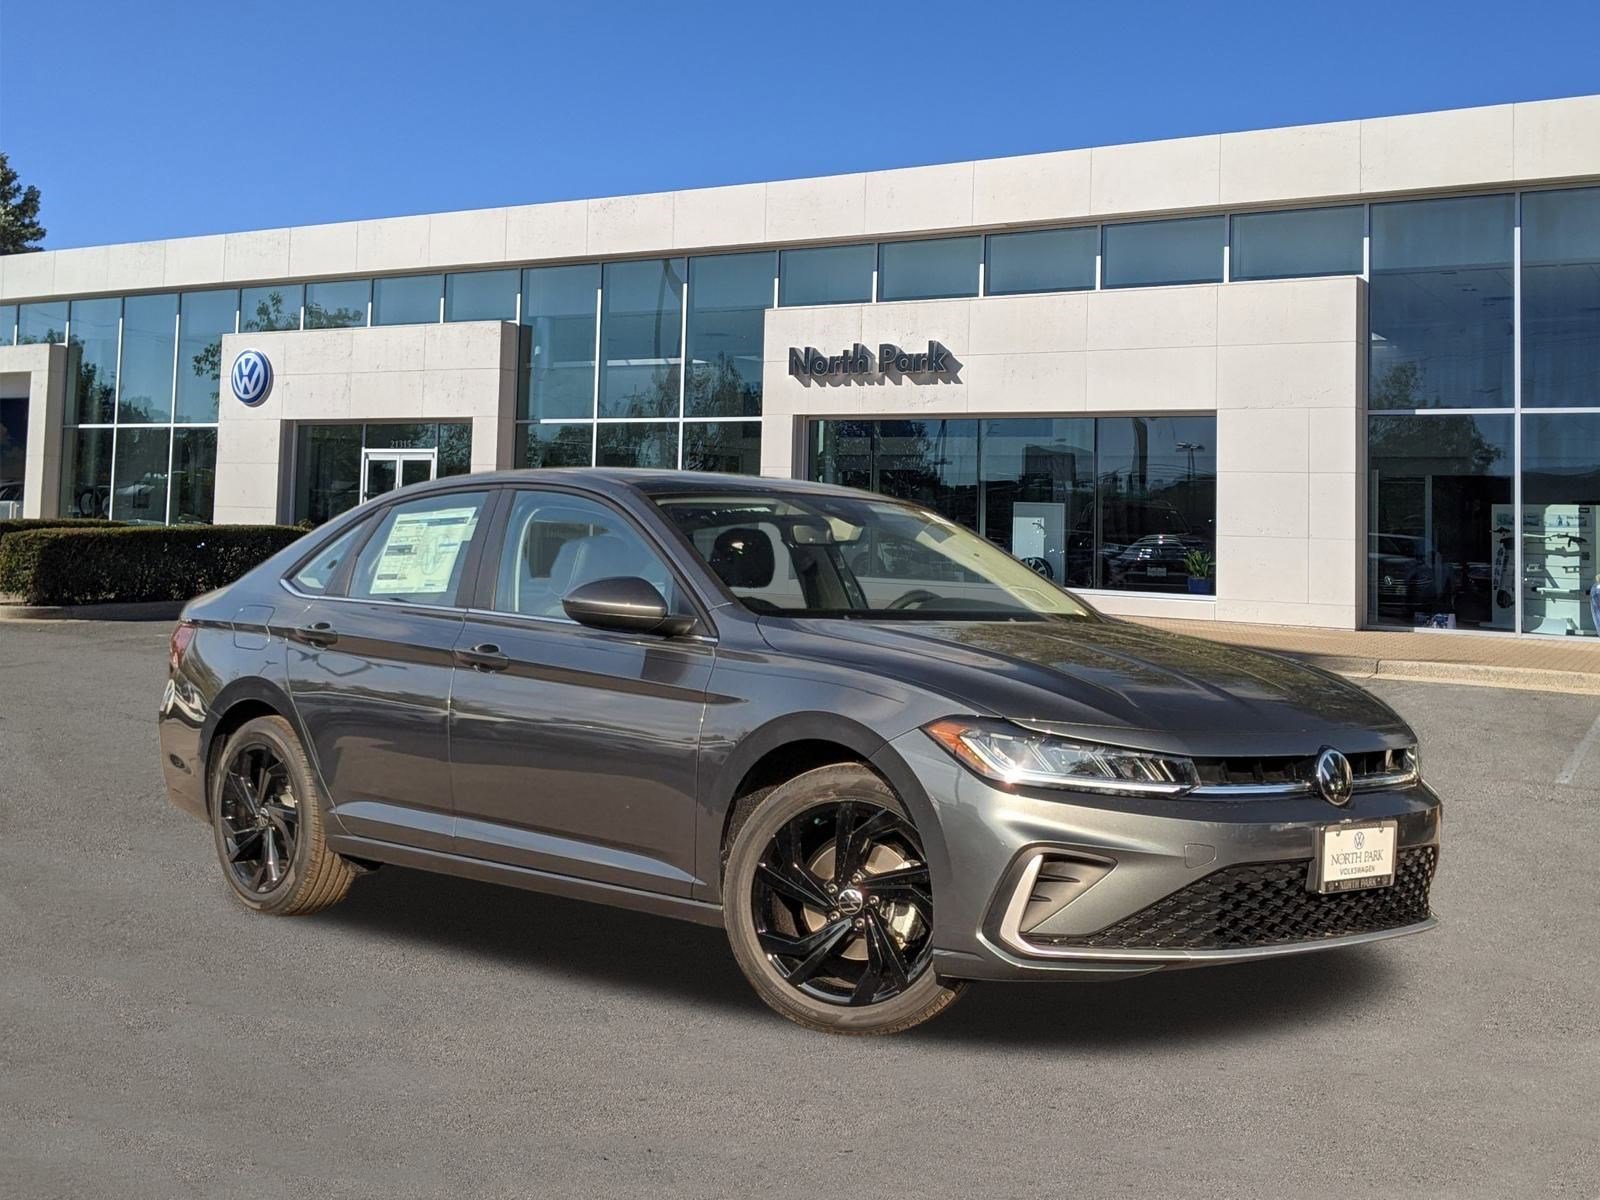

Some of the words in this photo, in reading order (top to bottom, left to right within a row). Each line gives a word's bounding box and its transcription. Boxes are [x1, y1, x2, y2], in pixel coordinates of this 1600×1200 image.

[789, 343, 870, 375] North
[879, 340, 947, 373] Park
[390, 440, 412, 449] 21315
[1331, 851, 1362, 866] NORTH
[1364, 849, 1384, 863] PARK
[1340, 865, 1376, 876] VOLKSWAGEN
